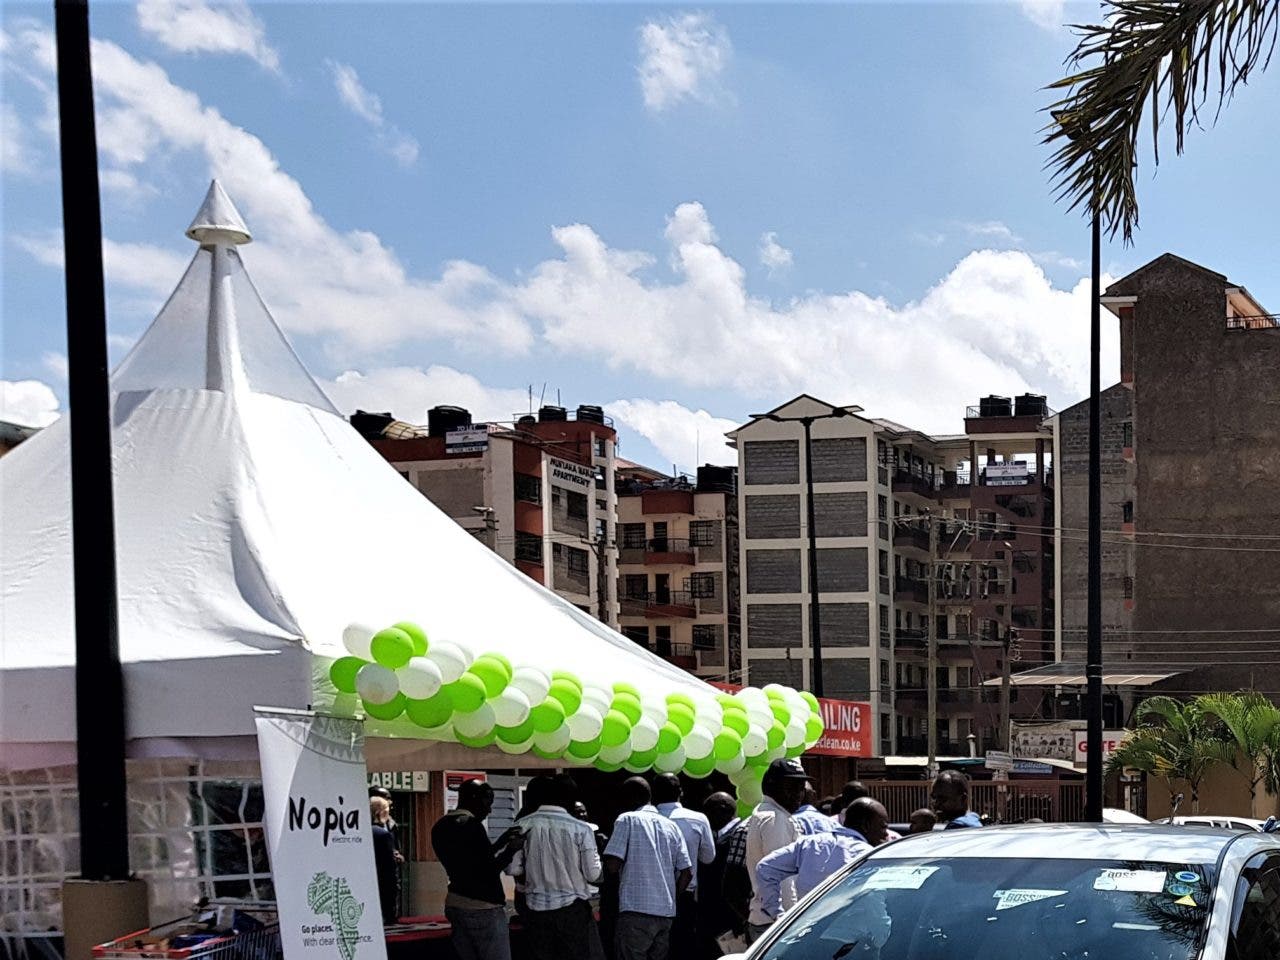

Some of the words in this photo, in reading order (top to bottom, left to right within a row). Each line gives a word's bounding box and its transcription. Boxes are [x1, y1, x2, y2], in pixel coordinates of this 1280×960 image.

[553, 469, 590, 487] APARTMENT
[1078, 741, 1116, 752] GTE
[367, 771, 411, 789] ABLE
[289, 795, 359, 847] Nopia
[301, 924, 311, 933] Go
[311, 923, 334, 936] places.
[303, 936, 317, 947] With
[319, 936, 335, 946] clear
